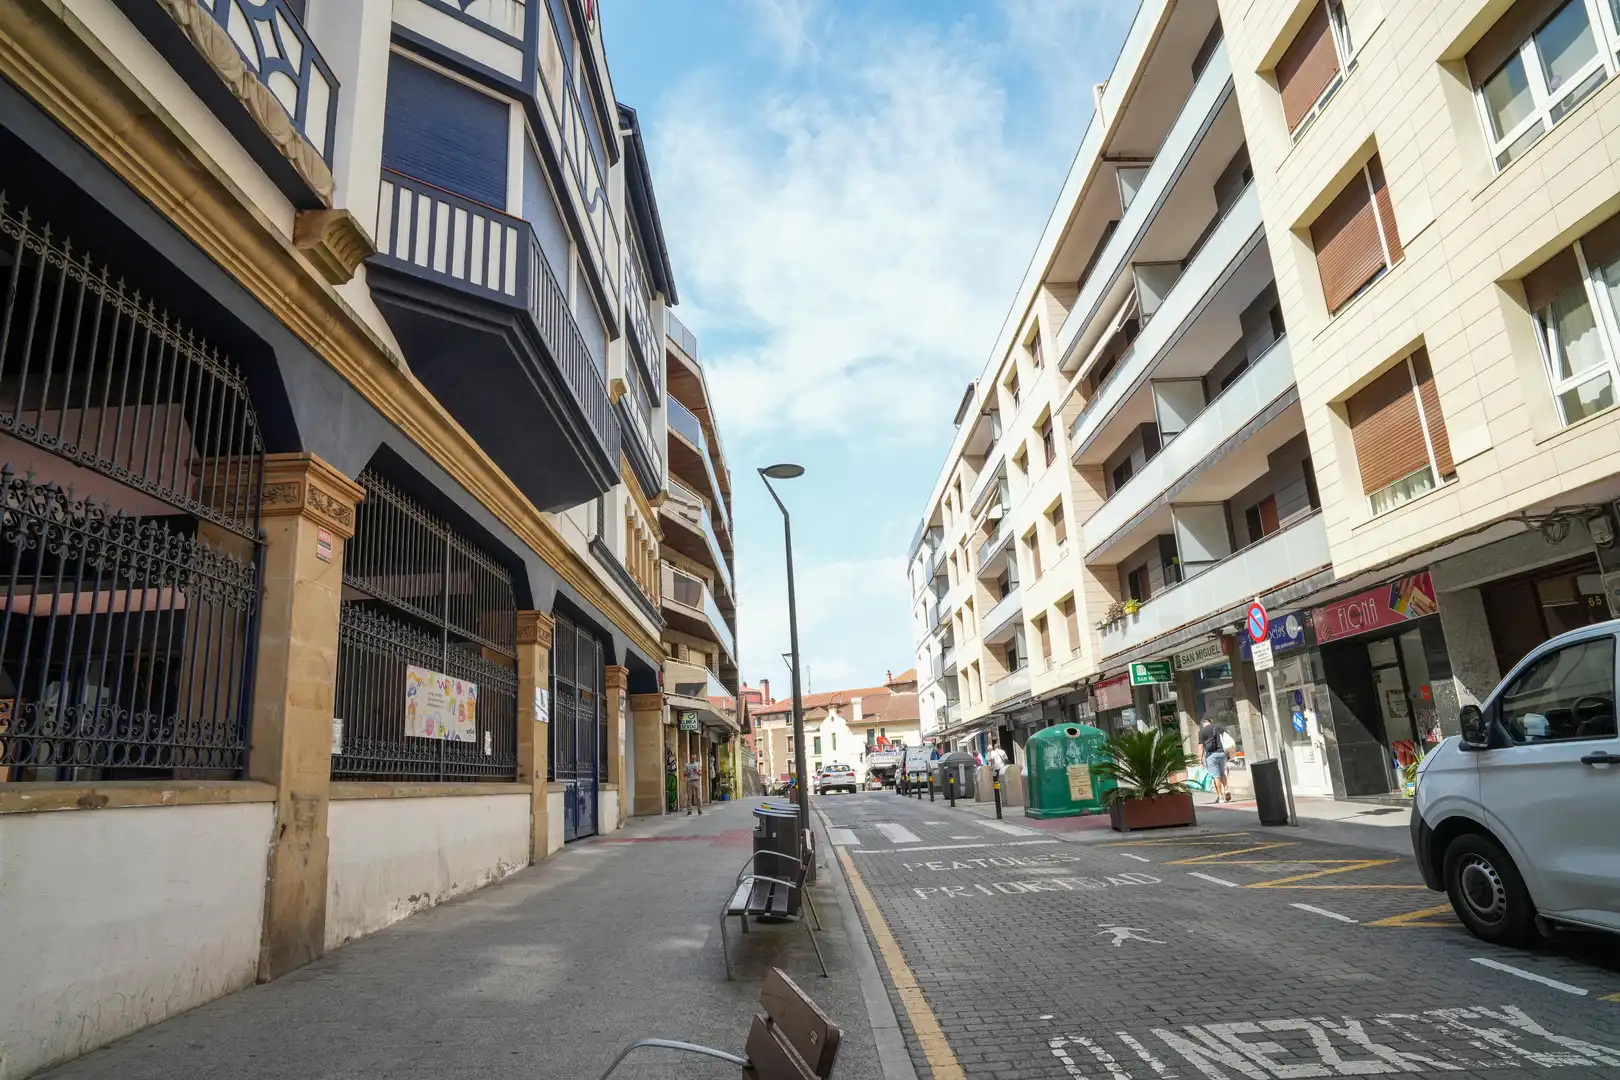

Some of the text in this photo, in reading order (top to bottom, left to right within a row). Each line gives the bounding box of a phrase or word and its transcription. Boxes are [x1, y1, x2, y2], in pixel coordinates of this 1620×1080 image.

[1338, 598, 1379, 632] FIONA
[1181, 653, 1195, 665] SAN
[1195, 644, 1221, 660] MIGUEL
[903, 853, 1080, 873] PEATONES
[913, 873, 1163, 900] PRIORIDAD
